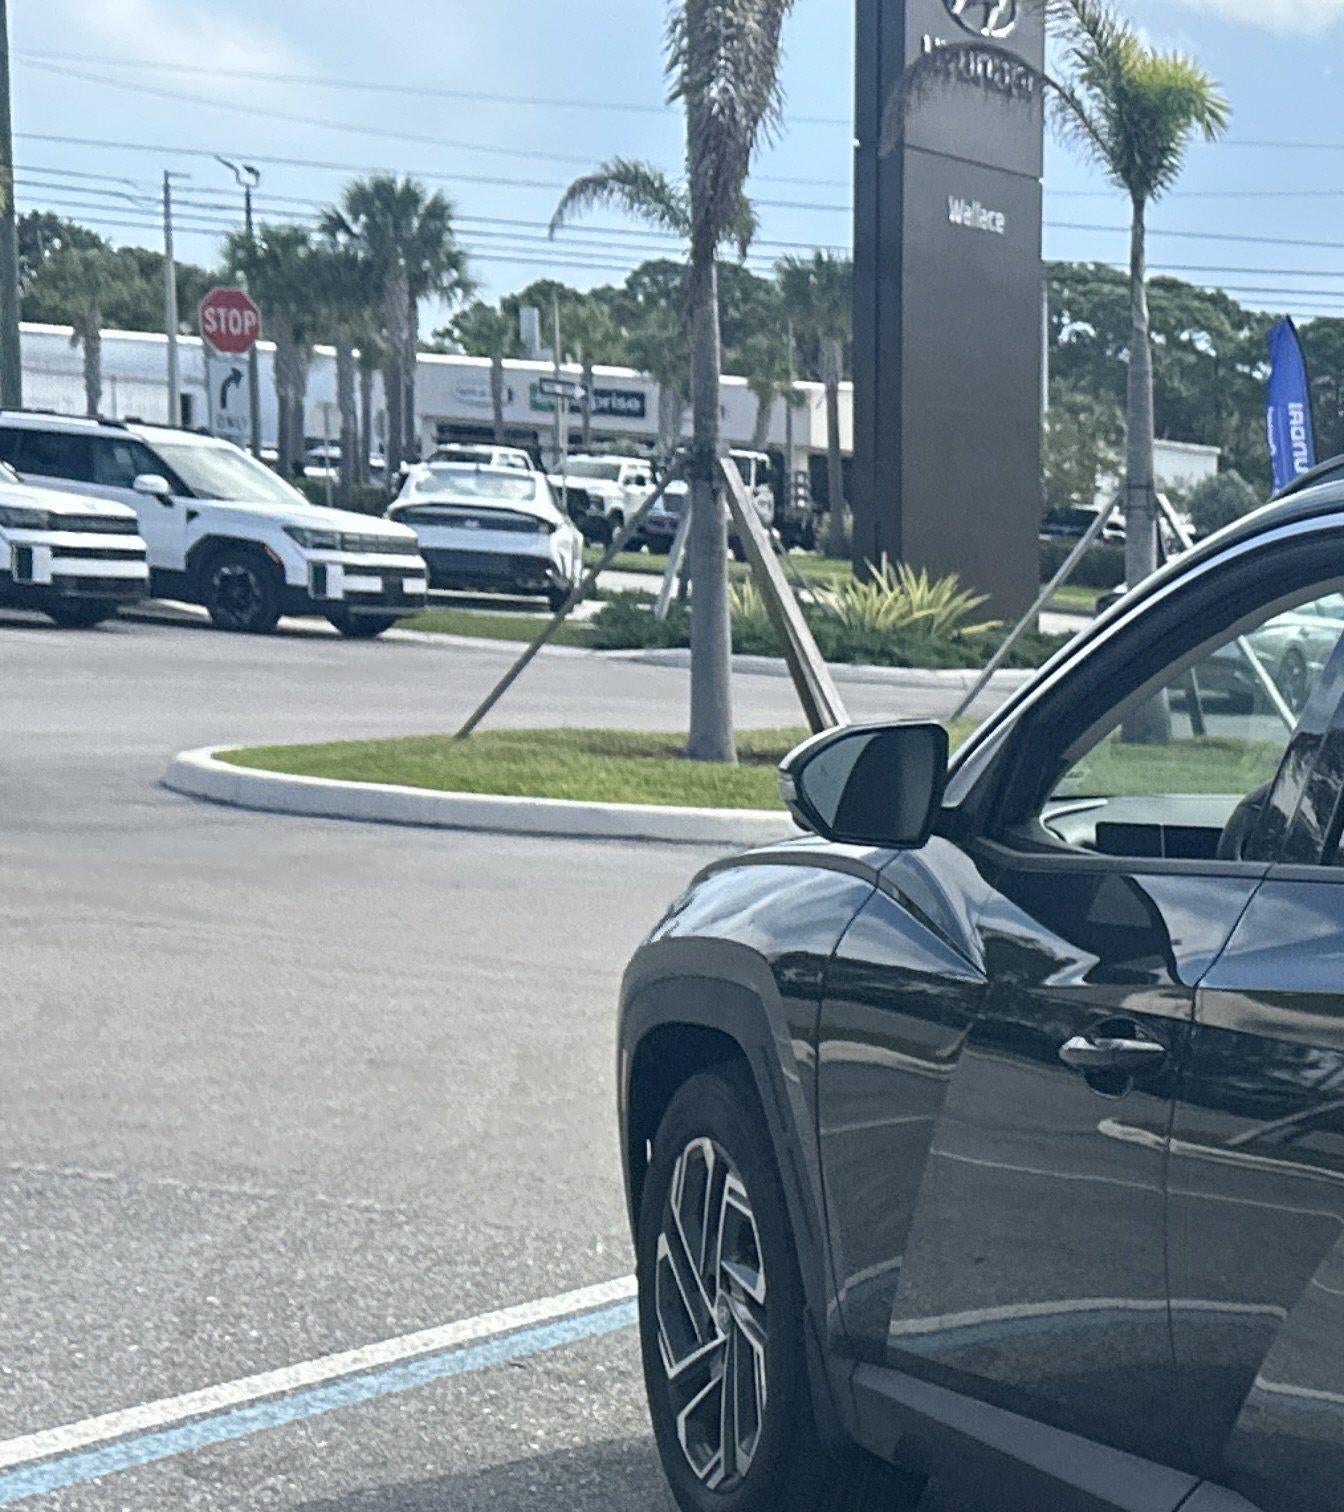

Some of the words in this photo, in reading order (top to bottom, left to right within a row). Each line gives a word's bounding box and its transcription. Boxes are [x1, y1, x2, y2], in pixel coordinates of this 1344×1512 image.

[947, 195, 1005, 234] Wallace
[204, 306, 257, 336] STOP
[216, 414, 248, 431] ONLY
